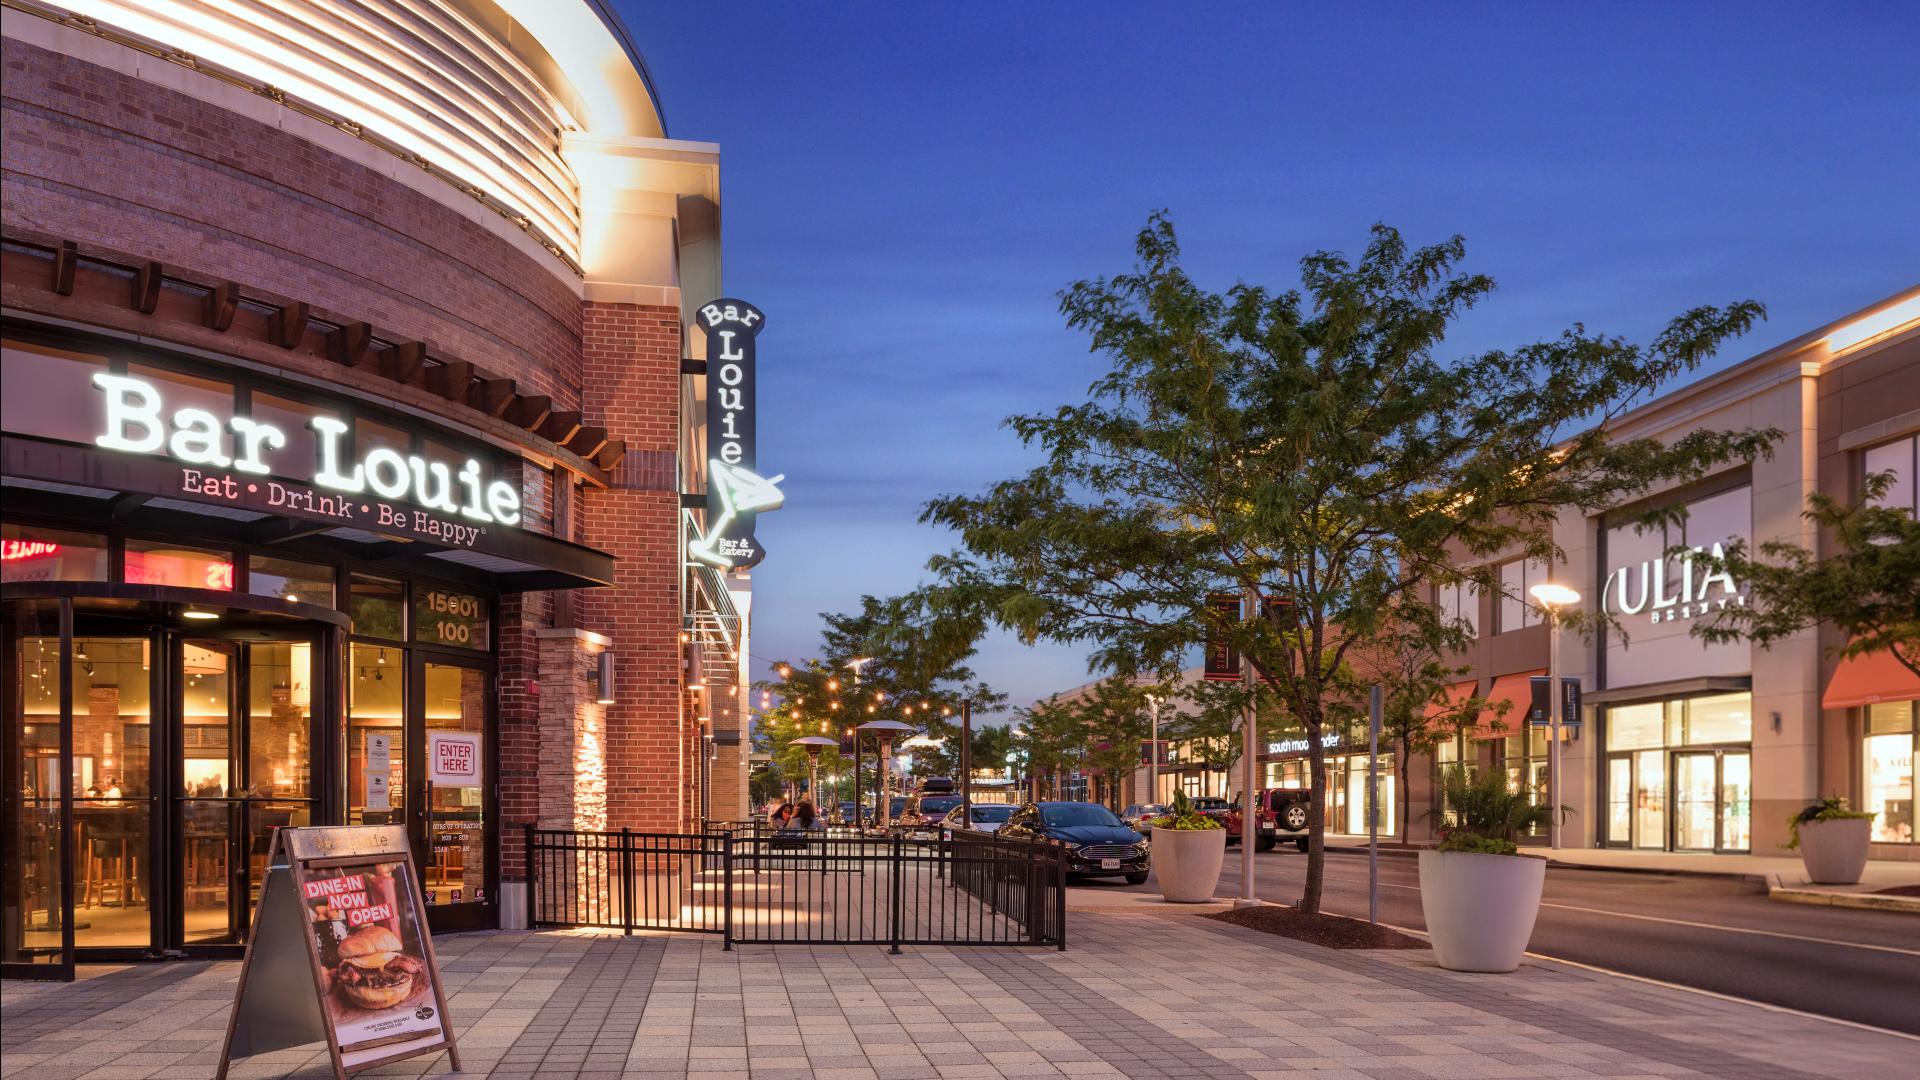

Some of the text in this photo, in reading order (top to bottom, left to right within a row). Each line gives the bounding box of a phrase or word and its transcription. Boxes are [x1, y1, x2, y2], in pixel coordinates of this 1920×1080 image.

[701, 304, 760, 328] Bar
[718, 331, 744, 464] Louie
[92, 372, 522, 526] Bar Louie
[182, 468, 239, 499] Eat
[267, 482, 353, 518] Drink
[377, 503, 406, 527] Be
[719, 538, 749, 548] Bar &
[719, 546, 755, 558] Eatery
[1618, 542, 1737, 615] ULTA
[427, 592, 478, 618] 15001
[437, 621, 469, 643] 100
[440, 744, 471, 759] ENTER
[1269, 733, 1340, 754] south moo nder
[443, 759, 468, 771] HERE
[306, 876, 363, 898] DINE-IN
[329, 892, 366, 910] NOW
[351, 904, 391, 925] OPEN
